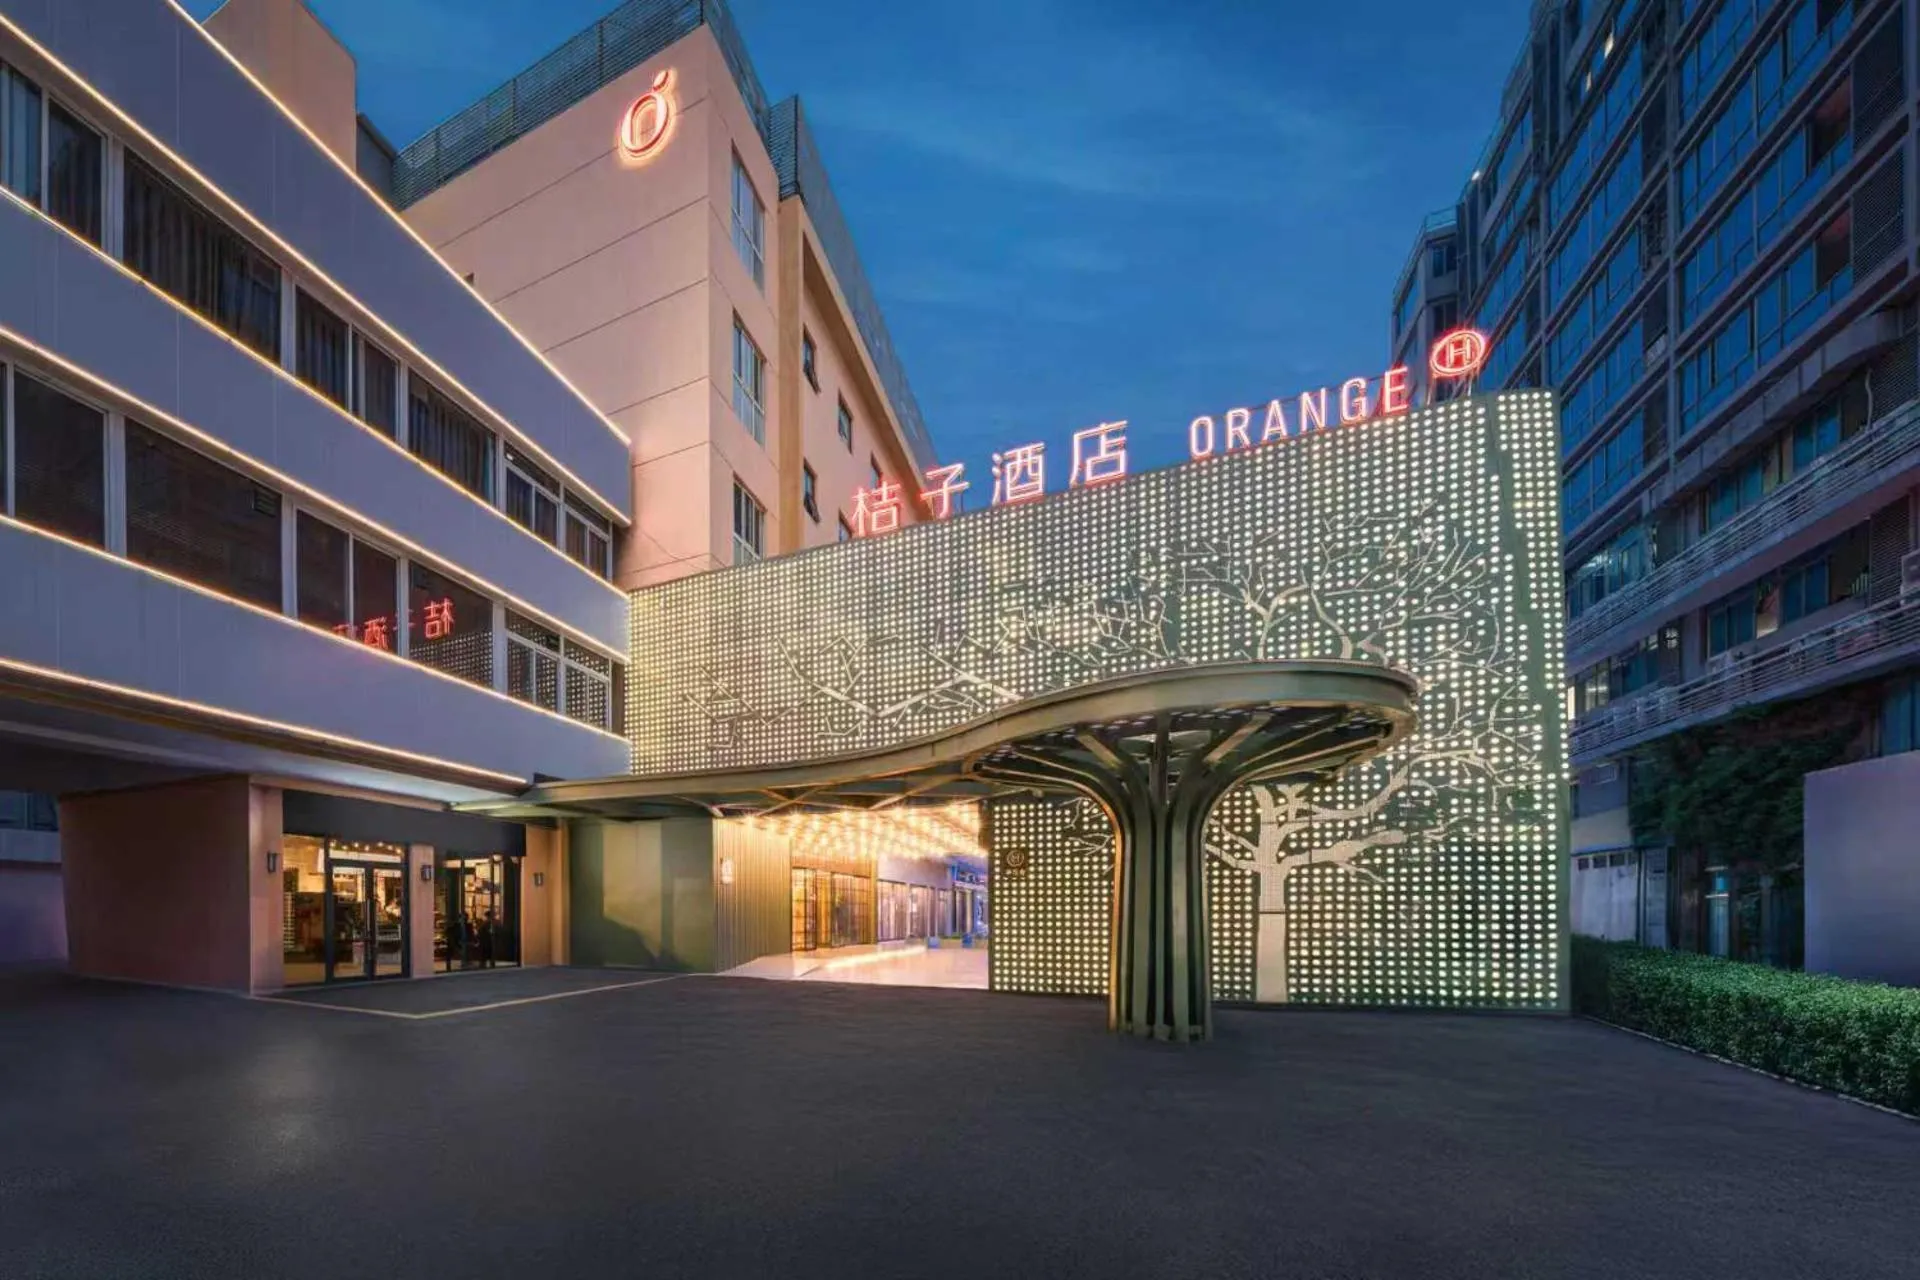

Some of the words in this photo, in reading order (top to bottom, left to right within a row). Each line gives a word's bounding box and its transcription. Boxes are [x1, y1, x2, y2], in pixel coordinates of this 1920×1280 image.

[1190, 366, 1409, 458] ORANGE
[852, 420, 1128, 537] 桔子酒店
